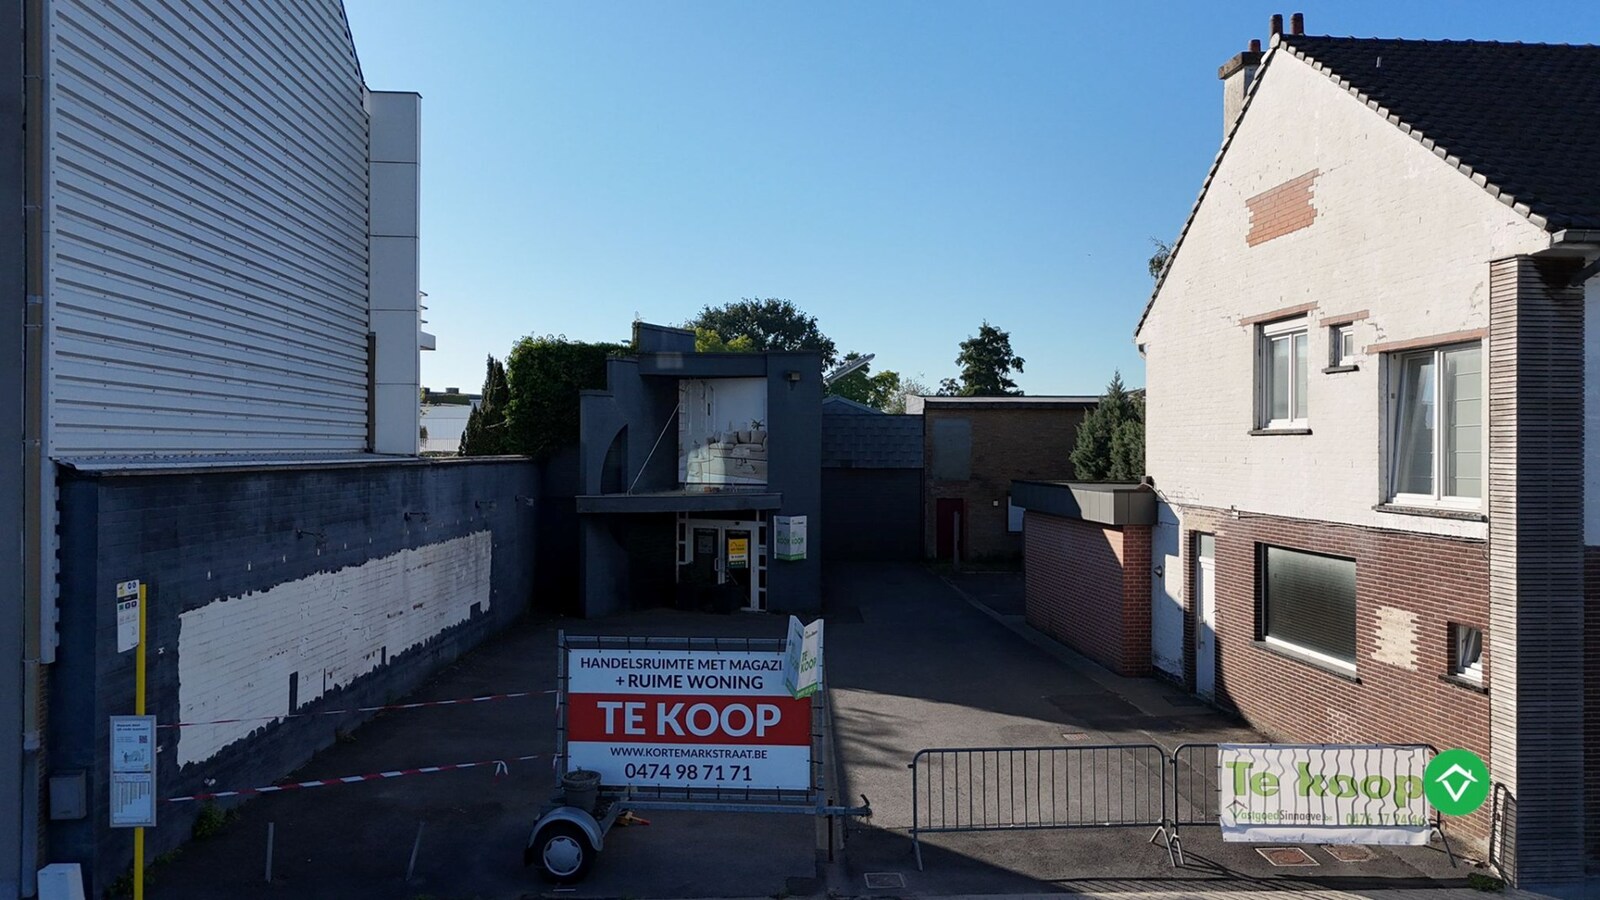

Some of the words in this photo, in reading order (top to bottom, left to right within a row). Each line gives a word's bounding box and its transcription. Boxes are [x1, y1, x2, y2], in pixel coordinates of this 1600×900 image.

[580, 657, 695, 671] HANDELSRUIMTE
[697, 659, 727, 671] MET
[729, 659, 784, 672] MAGAZI
[615, 676, 625, 686] +
[628, 674, 683, 689] RUIME
[686, 675, 764, 690] WONING
[597, 701, 647, 735] TE
[656, 702, 782, 738] KOOP
[610, 747, 768, 760] WWW.KORTEMARKSTRAAT.BE
[624, 763, 672, 780] 0474
[675, 764, 698, 781] 98
[702, 765, 725, 781] 71
[730, 765, 753, 782] 71
[1225, 761, 1280, 797] Te
[1297, 761, 1424, 808] koop
